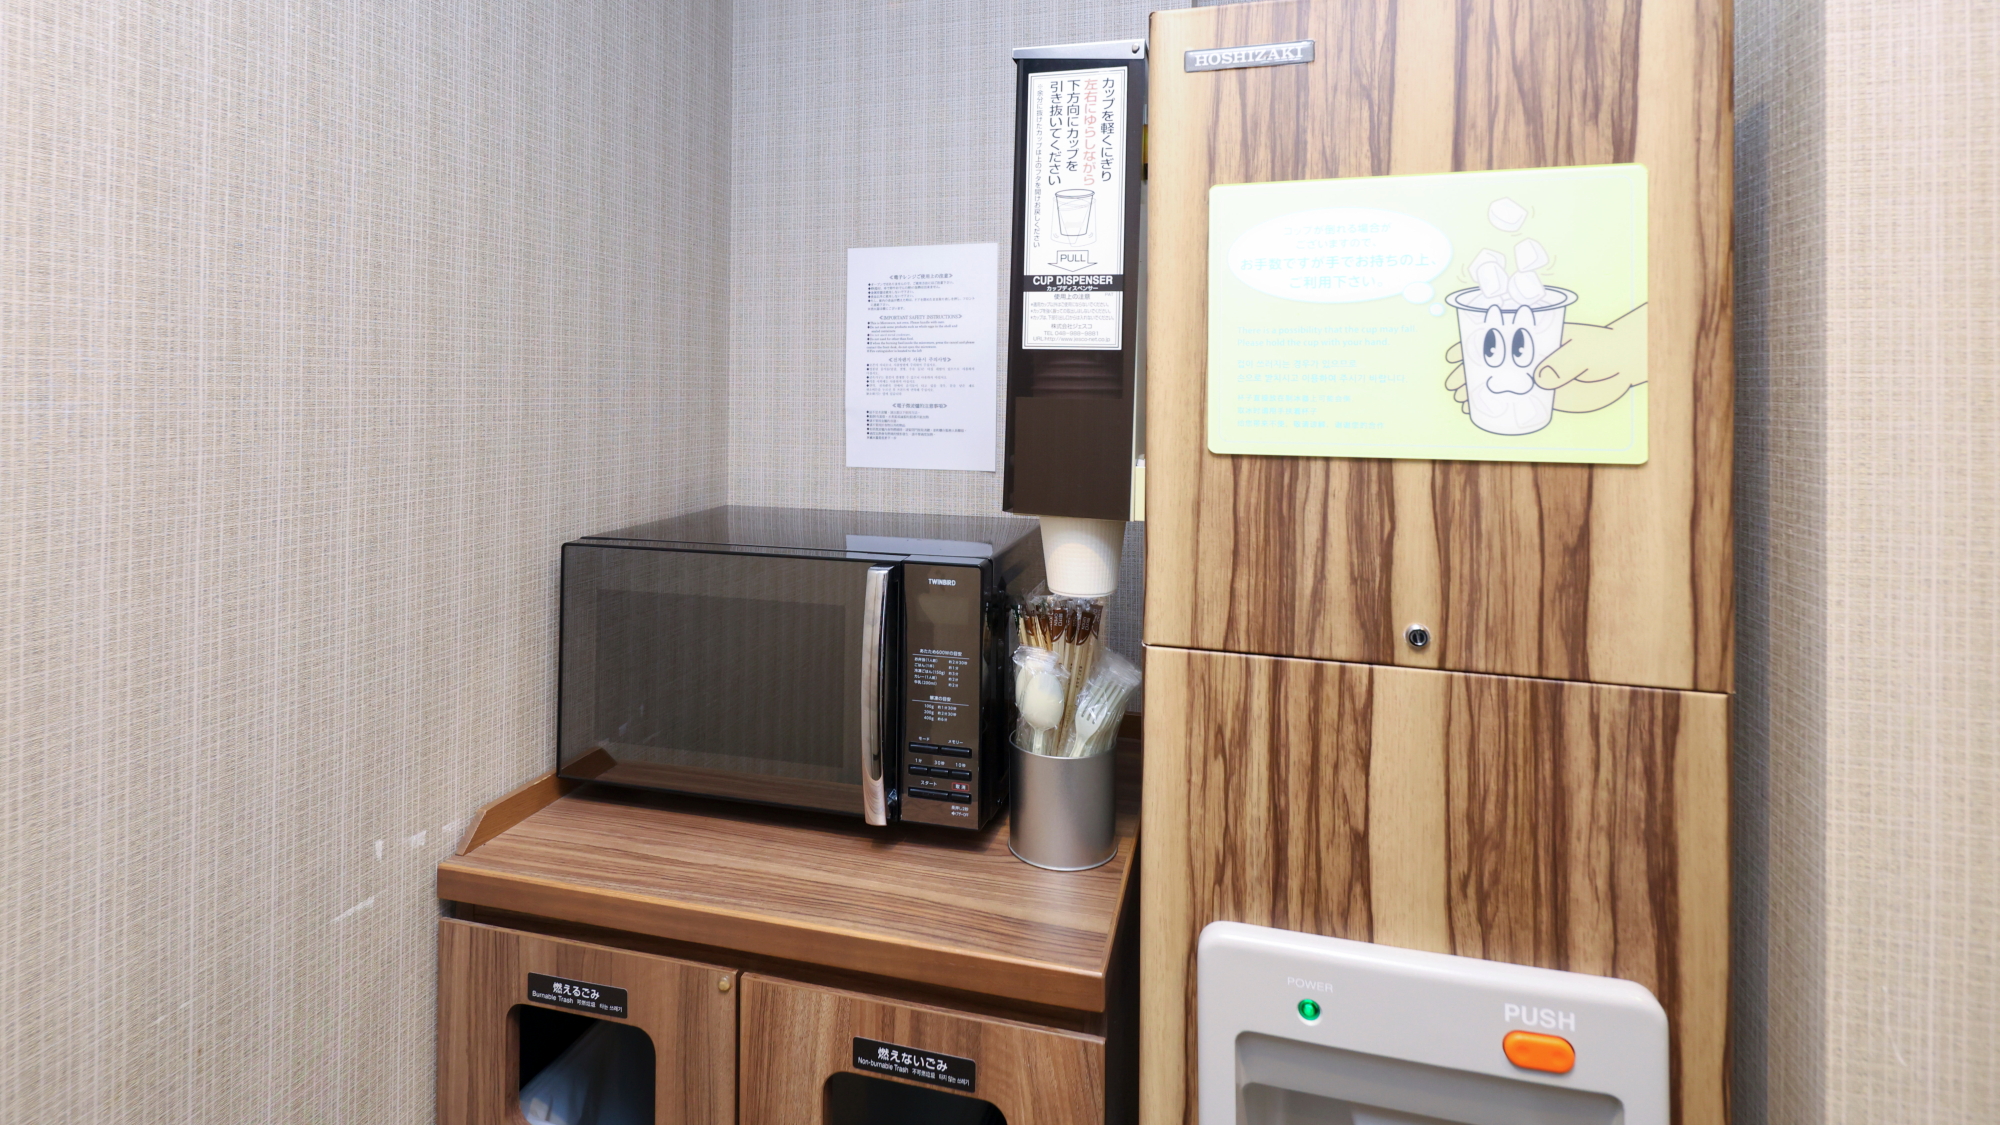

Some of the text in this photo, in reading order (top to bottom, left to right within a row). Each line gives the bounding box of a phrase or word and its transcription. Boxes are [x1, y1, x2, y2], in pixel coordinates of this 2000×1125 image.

[1194, 48, 1303, 67] HOSHIZAKI
[1048, 80, 1063, 186] 引き抜いてください
[1066, 79, 1081, 172] 下方向にカップを
[1083, 78, 1098, 186] 左右にゆらしながら
[1100, 77, 1115, 182] カップを軽くにぎり
[1060, 254, 1086, 262] PULL
[1240, 253, 1437, 271] お手数ですが手でお持ちの上、
[1033, 276, 1113, 285] CUP DISPENSER
[1290, 275, 1383, 289] ご利用下さい。
[1238, 326, 1261, 334] There
[1263, 326, 1270, 334] is
[1278, 326, 1322, 336] possibility
[1324, 326, 1343, 334] that
[1345, 326, 1359, 334] the
[1361, 327, 1378, 335] cup
[1380, 327, 1398, 335] may
[1237, 339, 1264, 347] Please
[1303, 340, 1319, 348] cup
[1321, 338, 1340, 346] with
[1365, 338, 1390, 346] hand.
[1256, 359, 1290, 368] 쓰러지는
[1294, 359, 1319, 368] 경우가
[1322, 359, 1357, 368] 있으므로
[1237, 374, 1262, 383] 손으로
[1302, 374, 1337, 383] 이용하여
[1339, 374, 1366, 383] 주시기
[928, 578, 956, 586] TWINBIRD
[552, 982, 600, 1000] 燃えるごみ
[1287, 976, 1334, 993] POWER
[532, 990, 574, 1004] Burnable Trash
[1504, 1003, 1576, 1032] PUSH
[858, 1057, 908, 1074] Non-burnable Trash
[877, 1046, 948, 1072] 燃えないごみ
